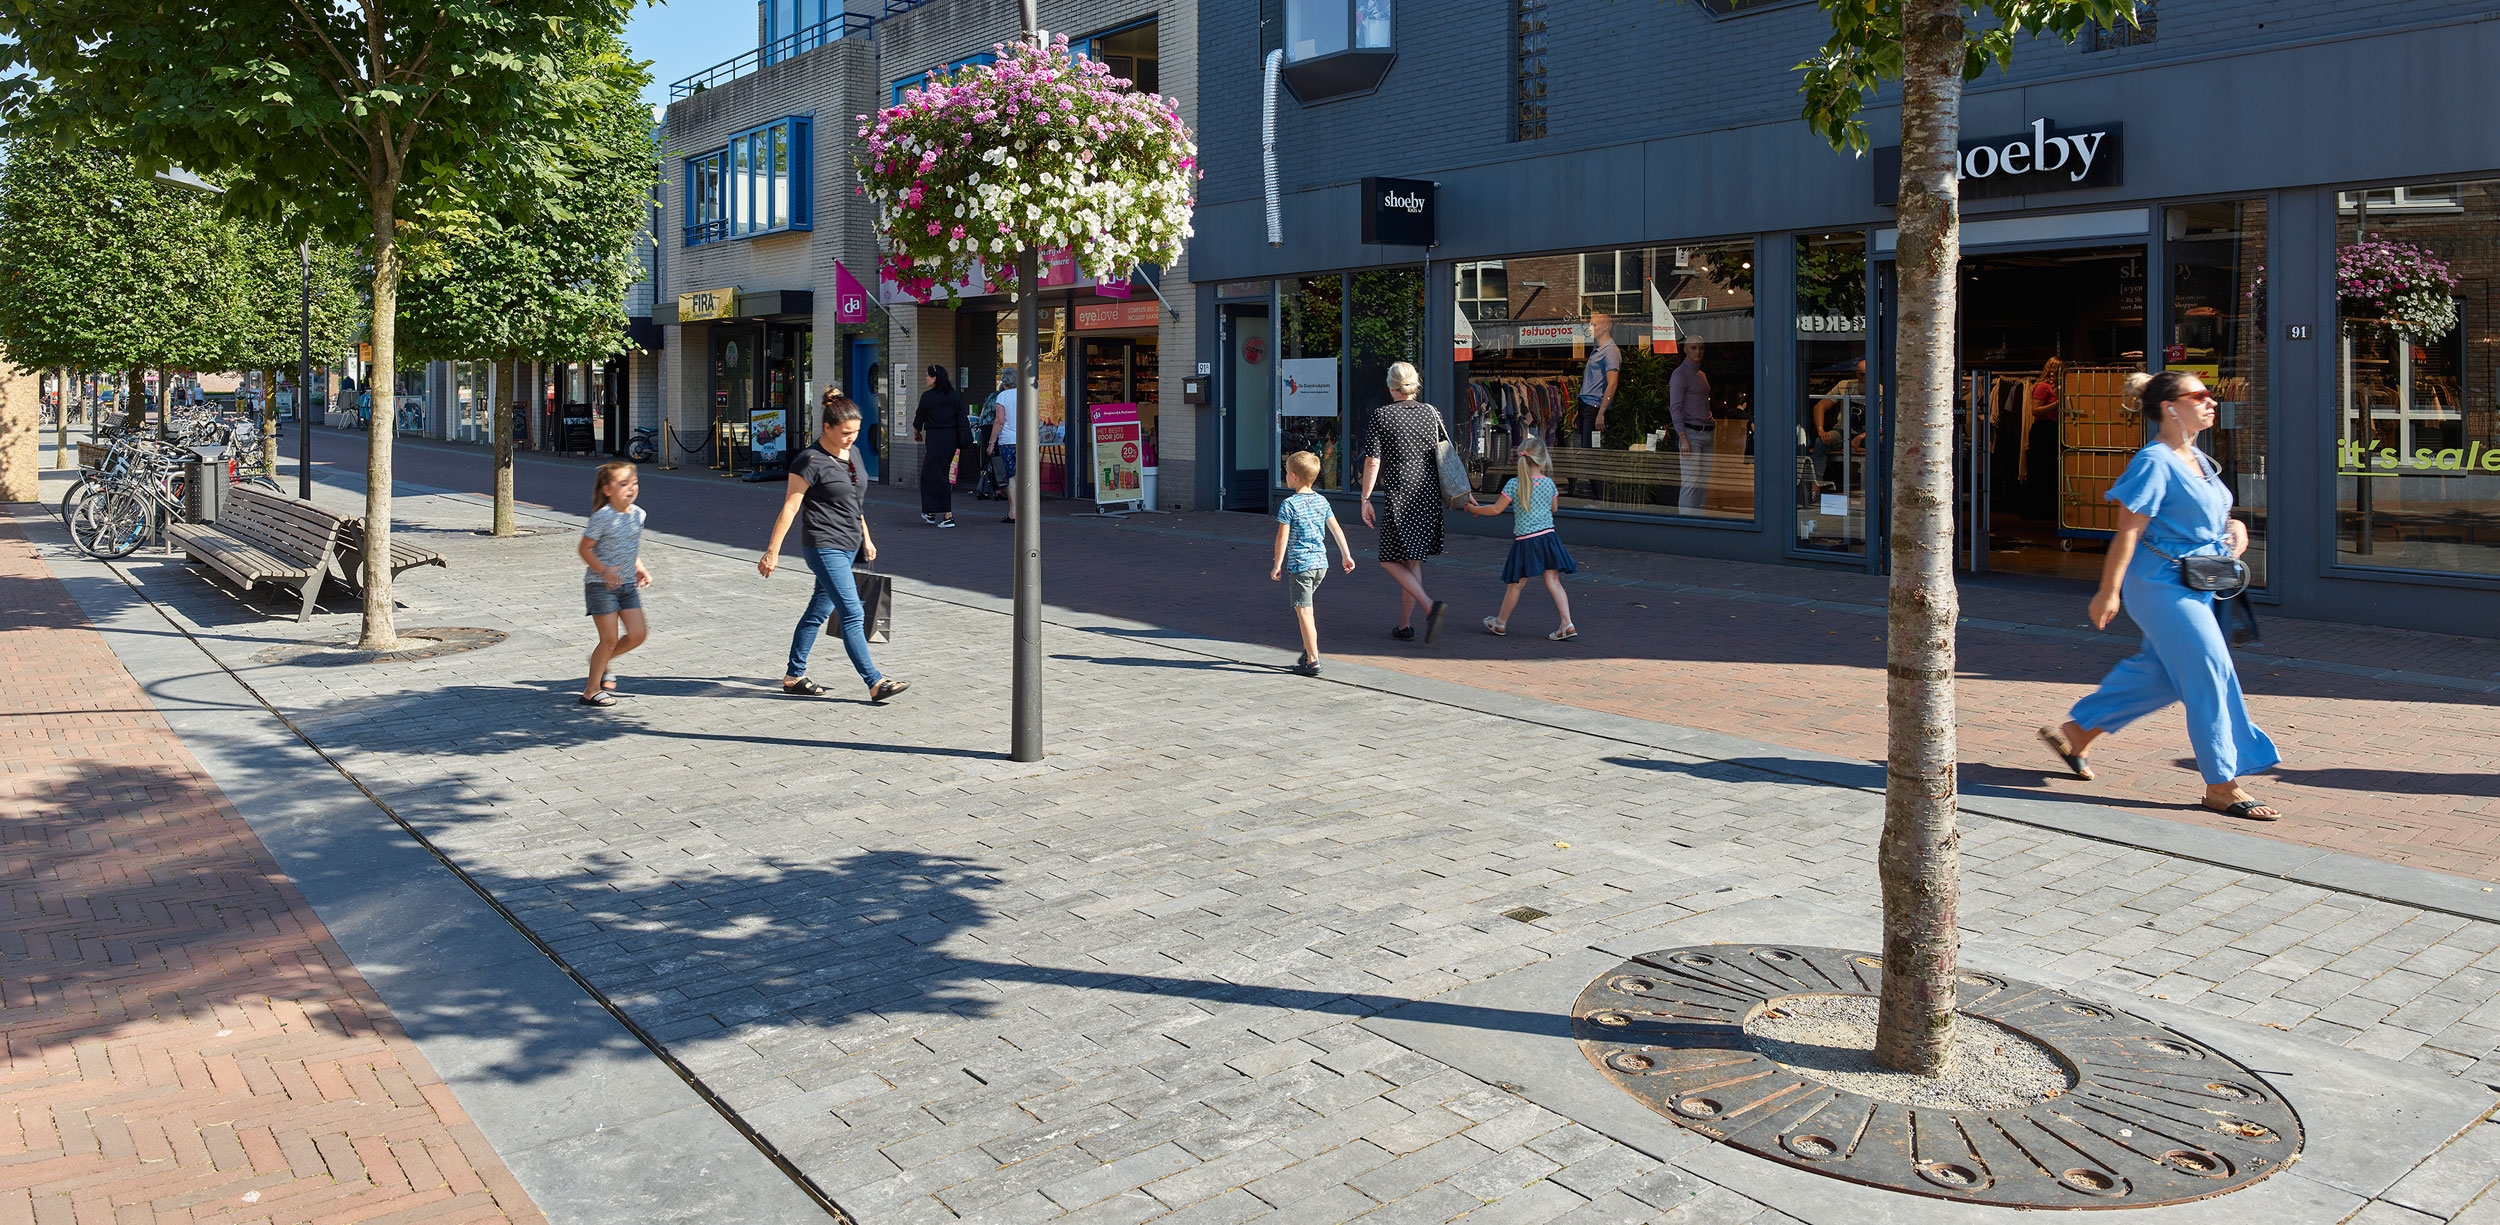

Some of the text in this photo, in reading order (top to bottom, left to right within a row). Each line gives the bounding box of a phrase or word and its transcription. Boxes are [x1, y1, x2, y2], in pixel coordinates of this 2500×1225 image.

[1957, 118, 2105, 182] oeby
[1384, 190, 1425, 213] shoeby
[693, 293, 714, 312] FIRA
[844, 297, 860, 313] da
[1080, 309, 1119, 326] eyelove
[2292, 326, 2306, 338] 91
[1114, 433, 1124, 441] JOU
[2412, 440, 2500, 471] sale
